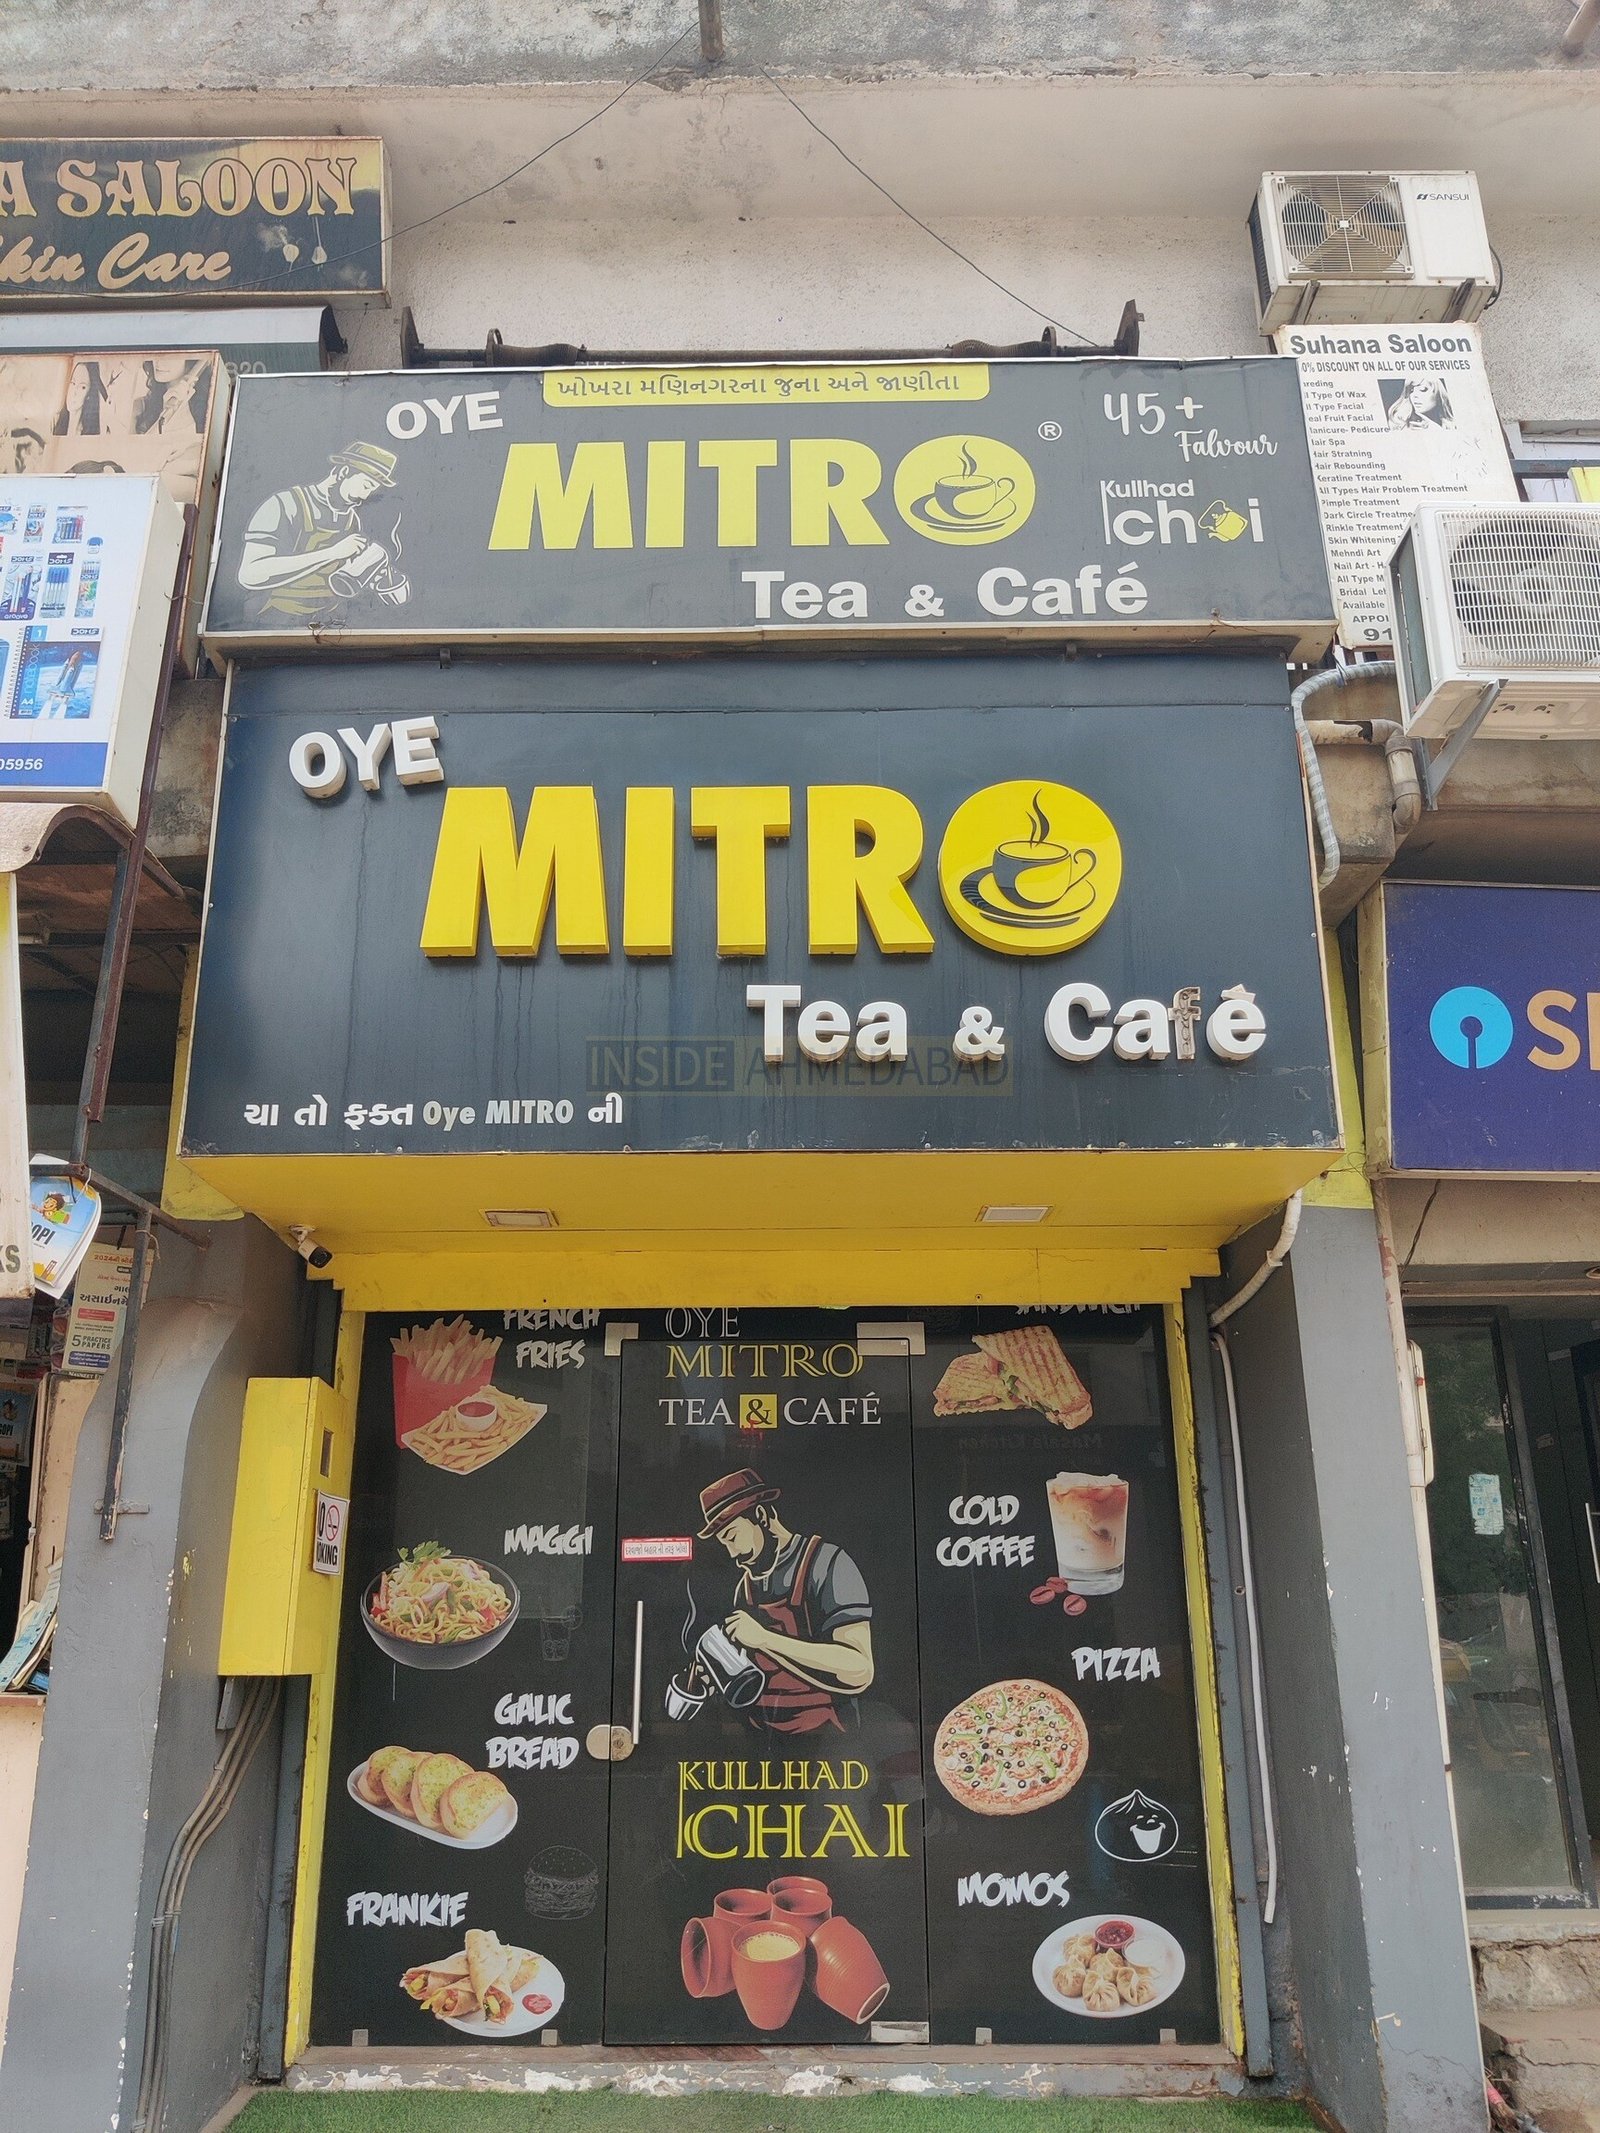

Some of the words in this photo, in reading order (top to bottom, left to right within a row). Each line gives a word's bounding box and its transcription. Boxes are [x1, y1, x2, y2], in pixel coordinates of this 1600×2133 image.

[56, 157, 358, 218] SALOON
[1430, 192, 1470, 201] SANSUI
[0, 235, 85, 283] kin
[98, 232, 231, 289] Care
[1290, 335, 1381, 355] Suhana
[1387, 334, 1472, 354] Saloon
[1317, 361, 1360, 373] DISCOUNT
[1363, 361, 1375, 372] ON
[1377, 360, 1393, 371] ALL
[1395, 360, 1406, 371] OF
[1409, 360, 1427, 371] OUR
[1429, 359, 1471, 371] SERVICES
[557, 376, 632, 397] ખોખરા
[640, 374, 767, 396] મણિનગરના
[774, 377, 820, 397] જુના
[828, 371, 869, 392] અને
[876, 370, 960, 392] જાણીતા
[1312, 391, 1333, 400] Type
[1348, 391, 1367, 399] Wax
[386, 390, 503, 439] OYE
[1314, 403, 1335, 412] Type
[1338, 402, 1365, 411] Facial
[1324, 414, 1346, 422] Fruit
[1347, 413, 1374, 422] Facial
[1328, 438, 1345, 447] Spa
[1350, 425, 1391, 434] Pedicure
[1174, 429, 1278, 462] Falvour
[1331, 450, 1373, 459] Stratning
[1334, 462, 1386, 471] Rebounding
[1355, 473, 1403, 482] Treatment
[488, 434, 1036, 551] MITRO
[1100, 479, 1195, 499] Kullhad
[1332, 486, 1359, 496] Types
[1361, 485, 1380, 494] Hair
[1382, 485, 1420, 494] Problem
[1421, 484, 1469, 493] Treatment
[1353, 498, 1401, 507] Treatment
[1326, 524, 1354, 532] Rinkle
[1356, 523, 1404, 531] Treatment
[1346, 511, 1374, 520] Circle
[1328, 536, 1349, 545] Skin
[1350, 536, 1397, 545] Whitening
[1331, 549, 1364, 557] Mehndi
[1366, 549, 1381, 557] Art
[1334, 562, 1352, 570] Nail
[1355, 561, 1370, 570] Art
[1337, 575, 1349, 583] All
[1351, 574, 1374, 584] Type
[741, 571, 868, 619] Tea
[904, 584, 944, 618] &
[977, 562, 1148, 616] Café
[1339, 588, 1367, 596] Bridal
[1342, 601, 1385, 610] Available
[289, 716, 444, 799] OYE
[420, 779, 1122, 957] MITRO
[746, 984, 908, 1063] Tea
[952, 1006, 1005, 1062] &
[1044, 983, 1267, 1062] Café
[244, 1104, 280, 1127] ચા
[294, 1094, 329, 1127] તો
[422, 1100, 476, 1132] Oye
[485, 1100, 574, 1124] MITRO
[588, 1092, 623, 1124] ની
[503, 1308, 601, 1331] FRENCH
[665, 1306, 740, 1338] OYE
[71, 1334, 82, 1347] 5
[516, 1339, 586, 1369] FRIES
[665, 1343, 864, 1379] MITRO
[659, 1398, 736, 1426] TEA
[745, 1398, 771, 1426] &
[783, 1391, 882, 1426] CAFÉ
[948, 1495, 1020, 1526] COLD
[504, 1524, 593, 1555] MAGGI
[936, 1535, 1035, 1568] COFFEE
[1071, 1646, 1160, 1681] PIZZA
[494, 1693, 575, 1726] GALIC
[485, 1736, 580, 1770] BREAD
[678, 1760, 869, 1791] KULLHAD
[683, 1803, 911, 1860] CHAI
[958, 1870, 1070, 1907] MOMOS
[347, 1891, 468, 1927] FRANKIE
